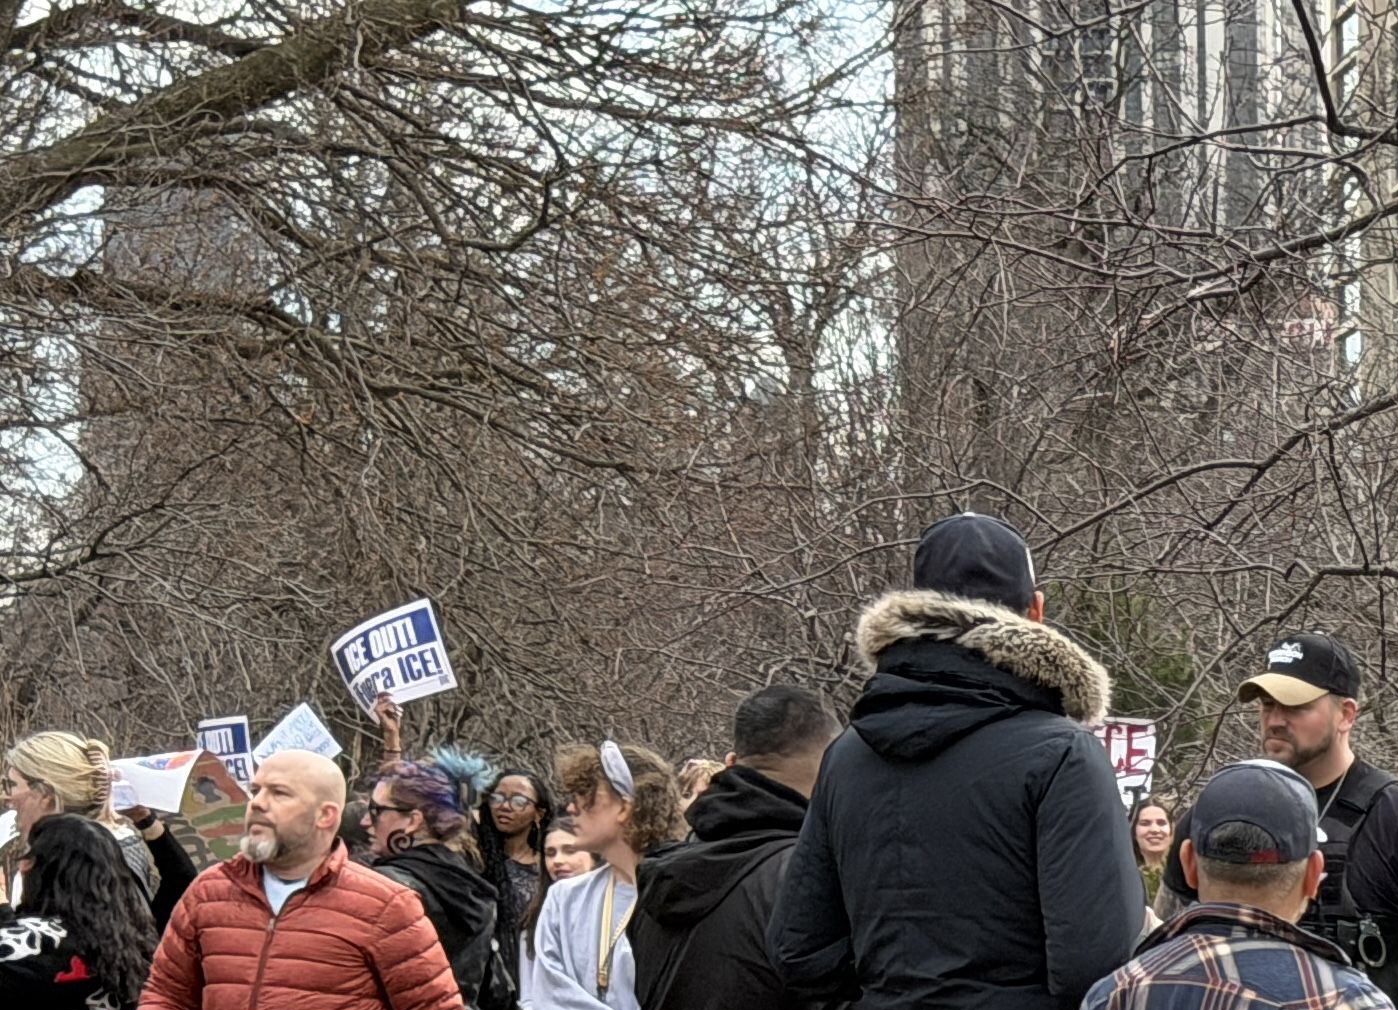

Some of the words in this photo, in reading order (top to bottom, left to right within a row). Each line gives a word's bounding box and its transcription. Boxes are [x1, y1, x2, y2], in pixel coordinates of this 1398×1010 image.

[343, 637, 370, 676] ICE
[368, 616, 418, 660] OUT!
[397, 647, 444, 685] ICE!
[1095, 724, 1148, 776] CE
